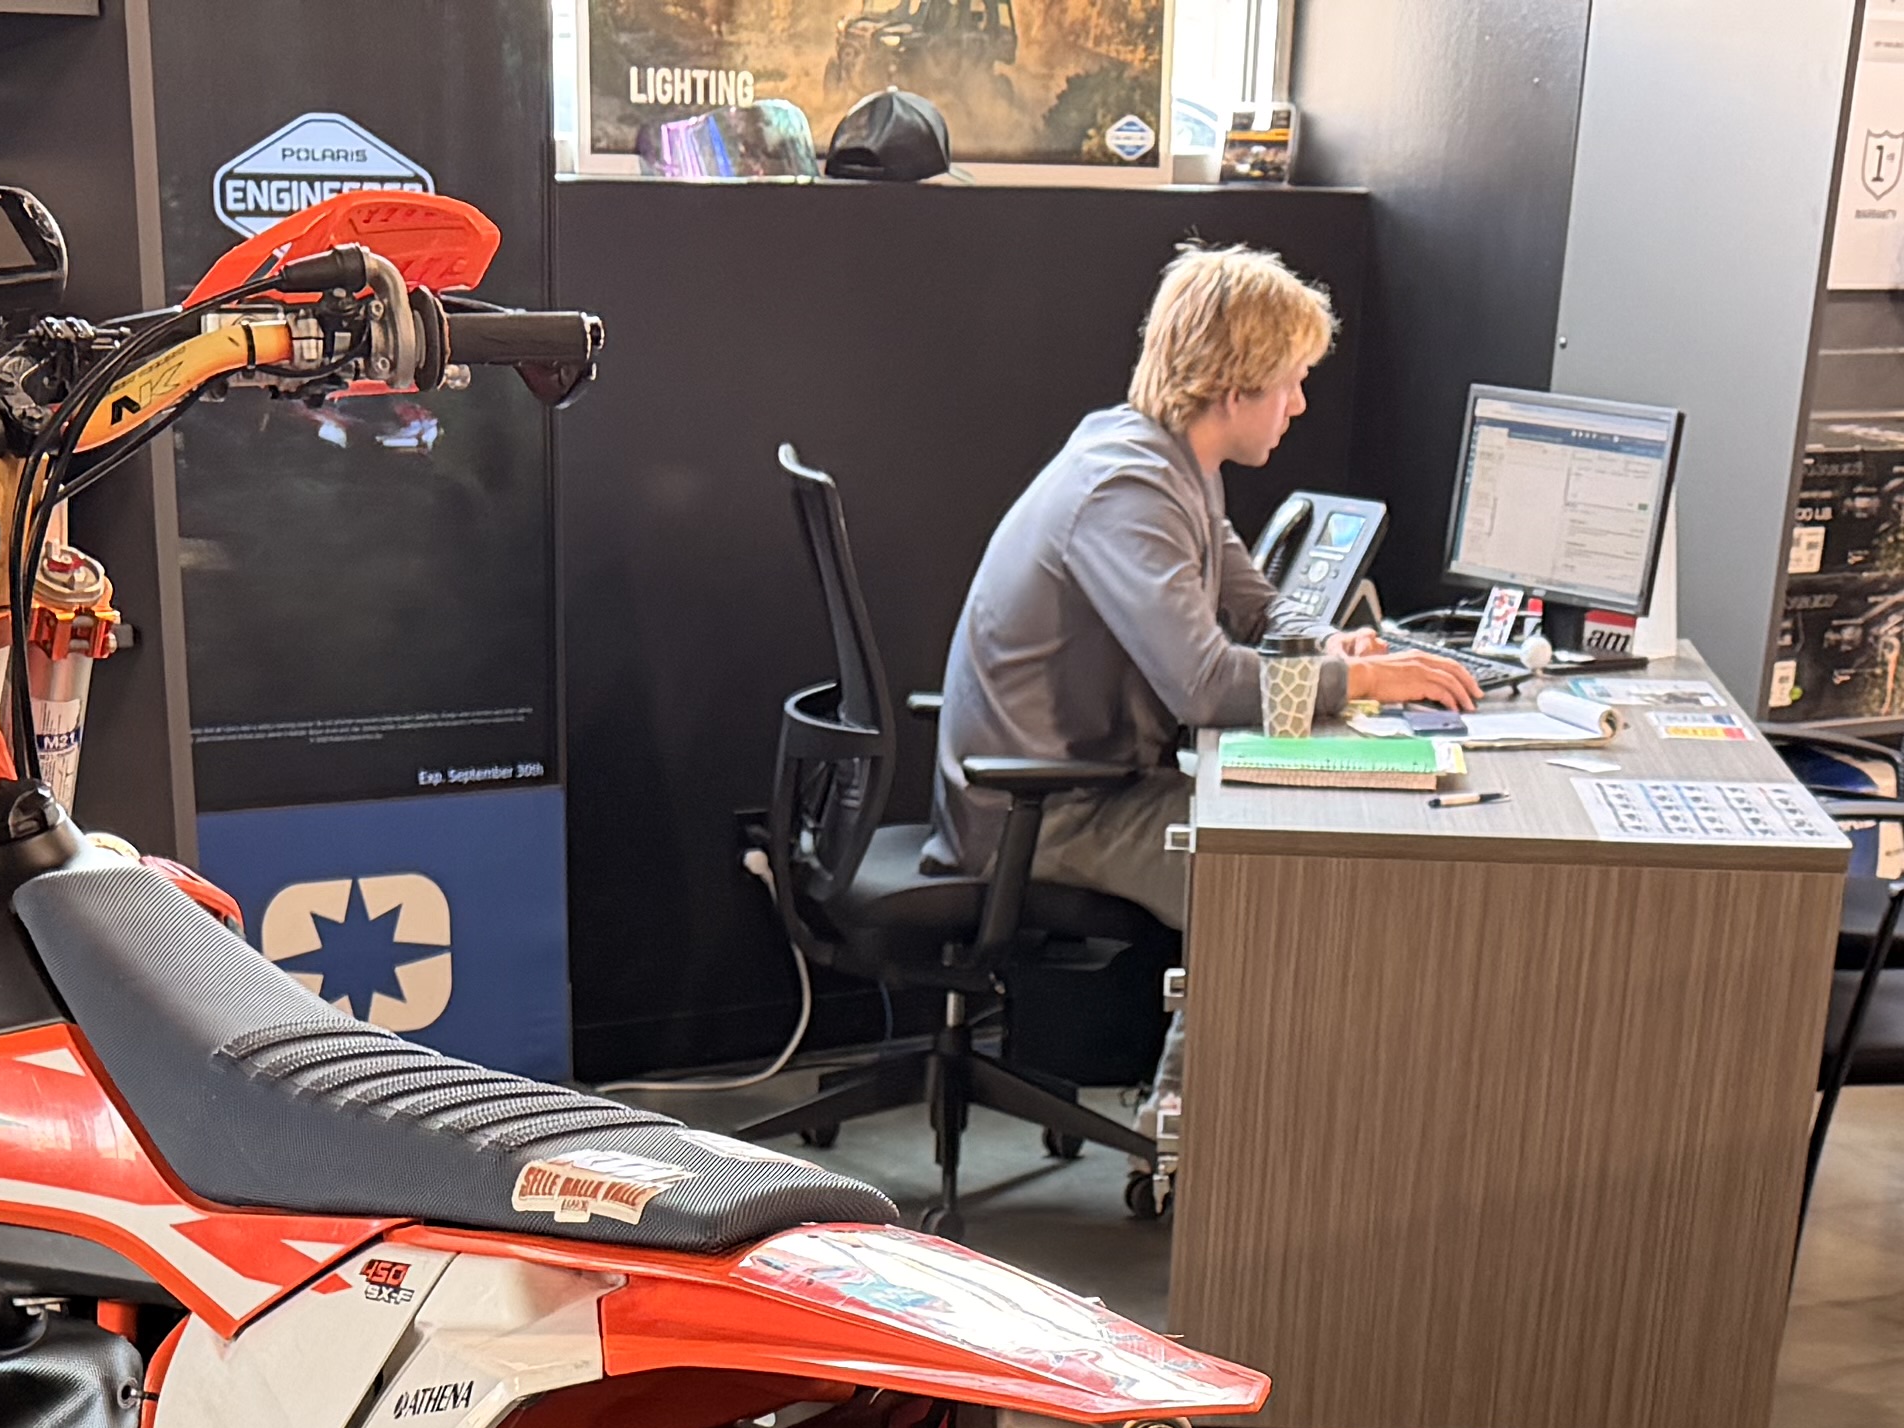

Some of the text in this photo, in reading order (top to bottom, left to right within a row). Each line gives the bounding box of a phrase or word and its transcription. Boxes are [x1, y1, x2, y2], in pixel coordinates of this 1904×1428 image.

[629, 66, 755, 108] LIGHTING
[281, 147, 368, 163] POLARIS
[225, 179, 423, 212] ENGINE
[417, 761, 545, 787] Exp. September 30th
[362, 1260, 409, 1287] 450
[365, 1284, 415, 1305] SX-F
[406, 1380, 475, 1417] ATHENA
